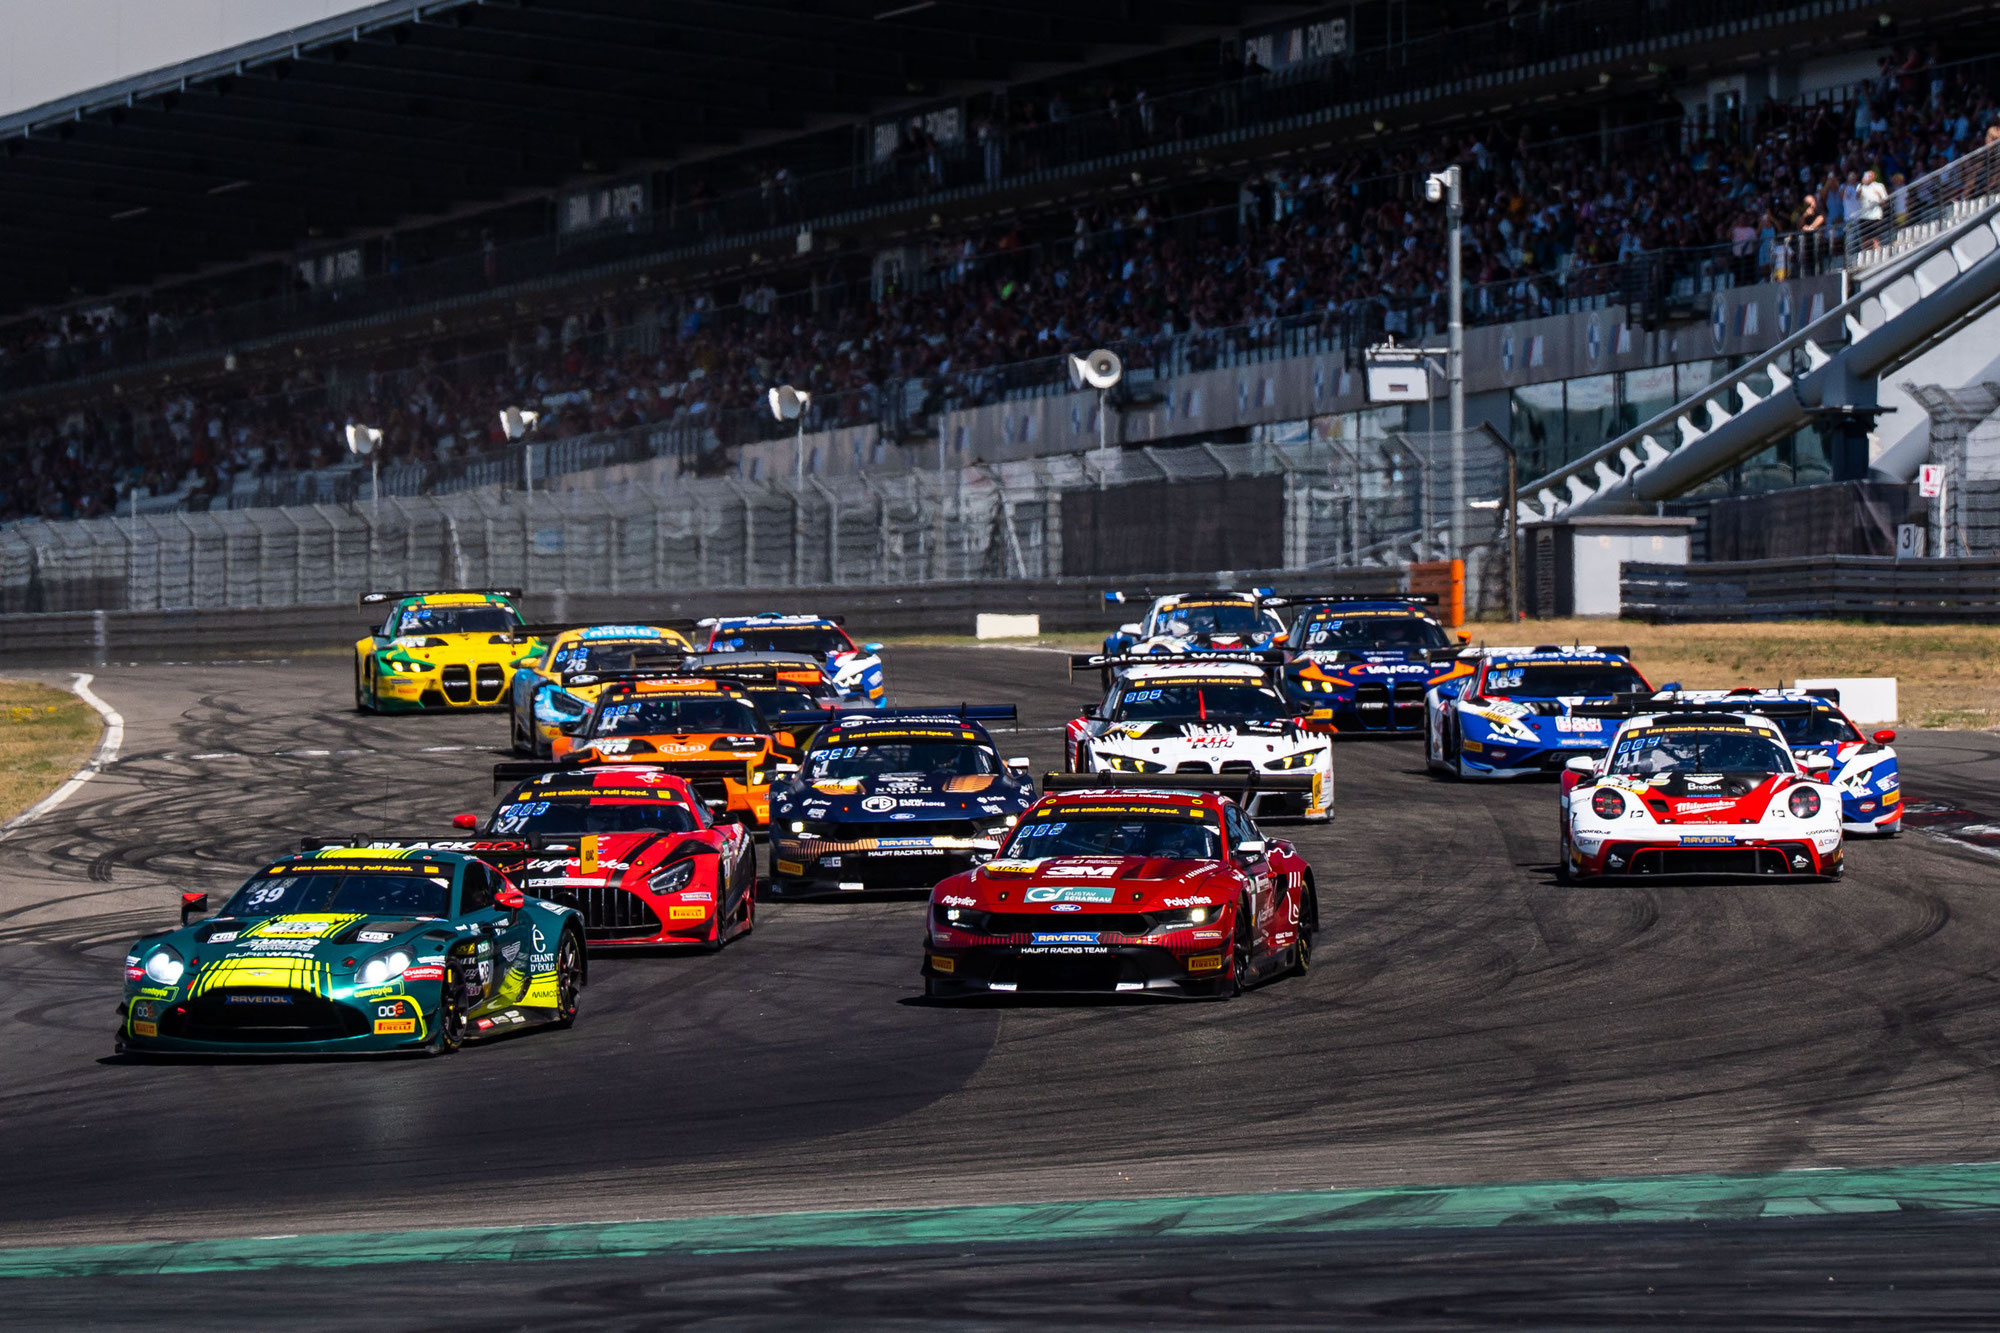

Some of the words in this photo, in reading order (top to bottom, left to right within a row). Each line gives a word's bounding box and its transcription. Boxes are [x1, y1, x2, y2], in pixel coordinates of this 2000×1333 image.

[1308, 18, 1347, 57] POWER
[1306, 631, 1328, 645] 10
[564, 659, 587, 673] 26
[1488, 677, 1522, 690] 163
[1616, 751, 1641, 768] 41
[1674, 800, 1736, 812] Milwaukee
[1045, 866, 1118, 876] 3M
[248, 887, 285, 905] 39
[530, 953, 554, 962] CHANT
[378, 1021, 412, 1031] PIRELLI
